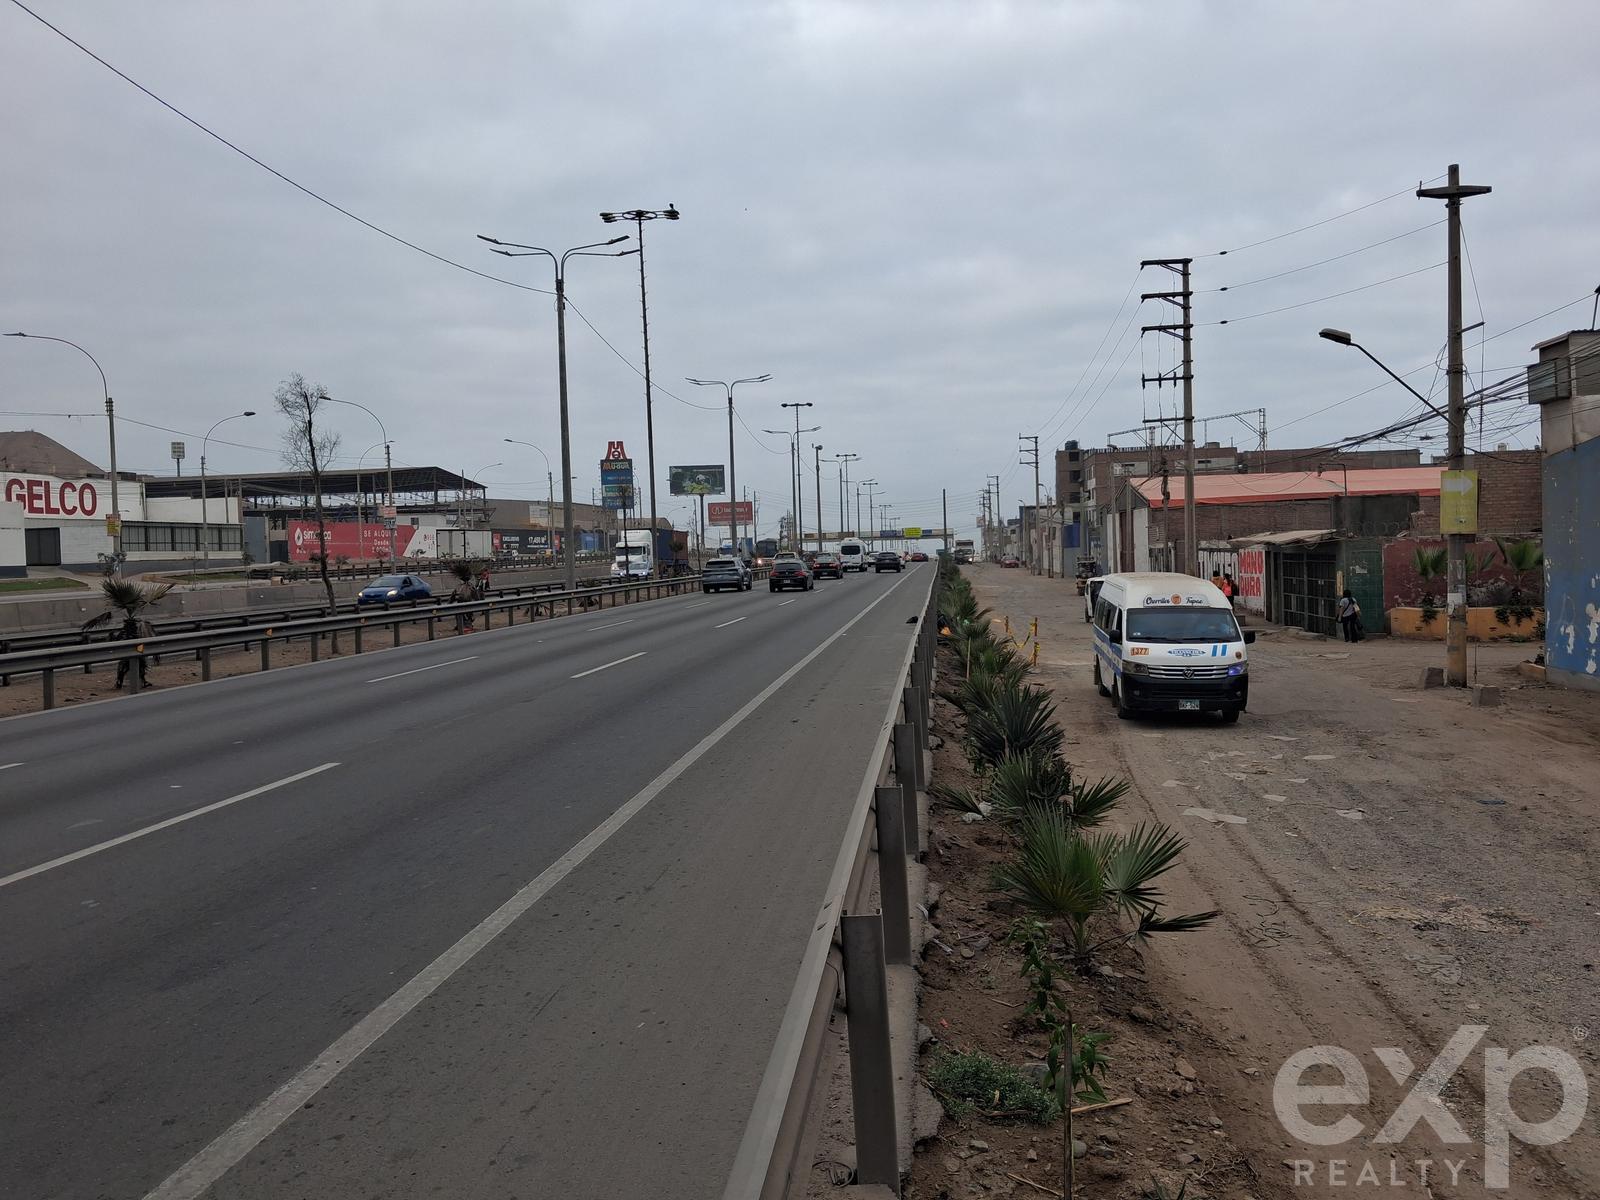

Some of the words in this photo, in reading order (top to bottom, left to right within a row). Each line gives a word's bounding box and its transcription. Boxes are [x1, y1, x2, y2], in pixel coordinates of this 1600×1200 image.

[5, 478, 97, 517] GELCO
[363, 530, 372, 538] SE
[374, 529, 398, 538] ALQUIA
[1239, 550, 1264, 574] MANO
[1240, 576, 1262, 597] DURA
